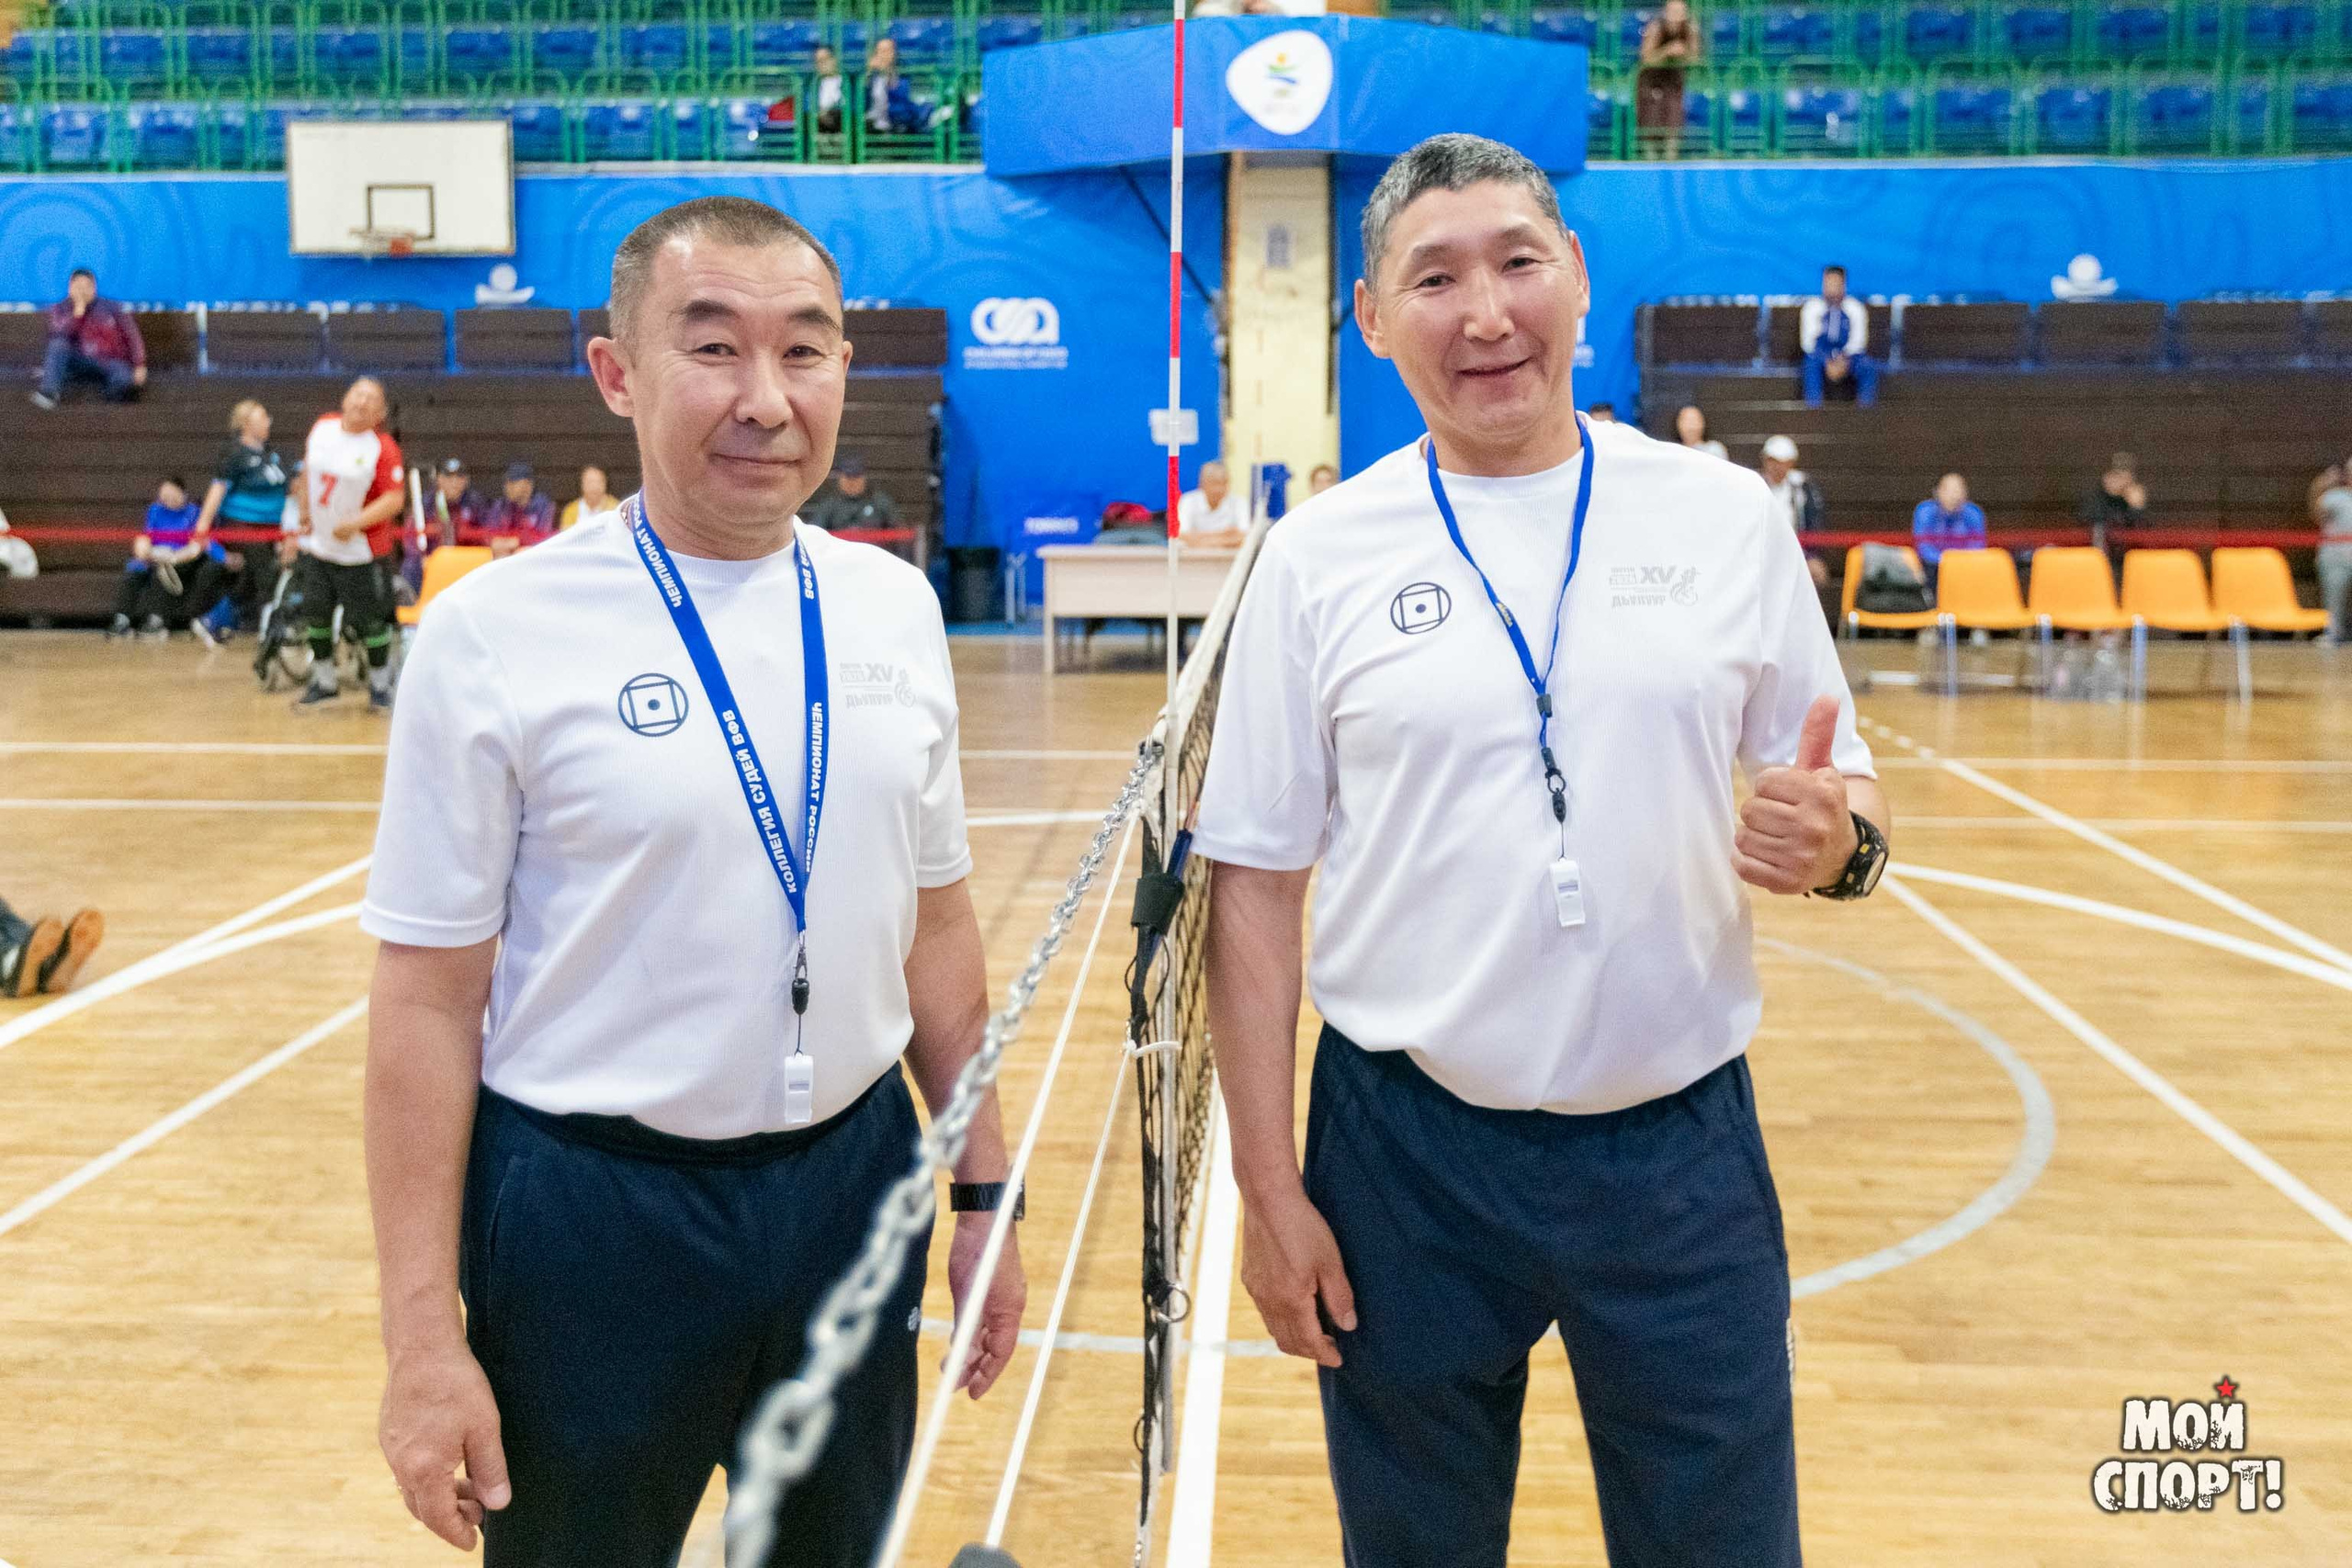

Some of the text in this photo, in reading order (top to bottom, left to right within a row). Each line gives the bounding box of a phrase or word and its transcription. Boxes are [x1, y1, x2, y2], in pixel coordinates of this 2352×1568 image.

[320, 472, 337, 507] 7
[637, 528, 683, 608] ЧЕМПИОНАТ
[1640, 565, 1677, 585] XV
[722, 709, 797, 893] КОЛЛЕГИЯ СУДЕЙ ВФВ
[805, 702, 822, 873] ЧЕМПИОНАТ РОССИИ
